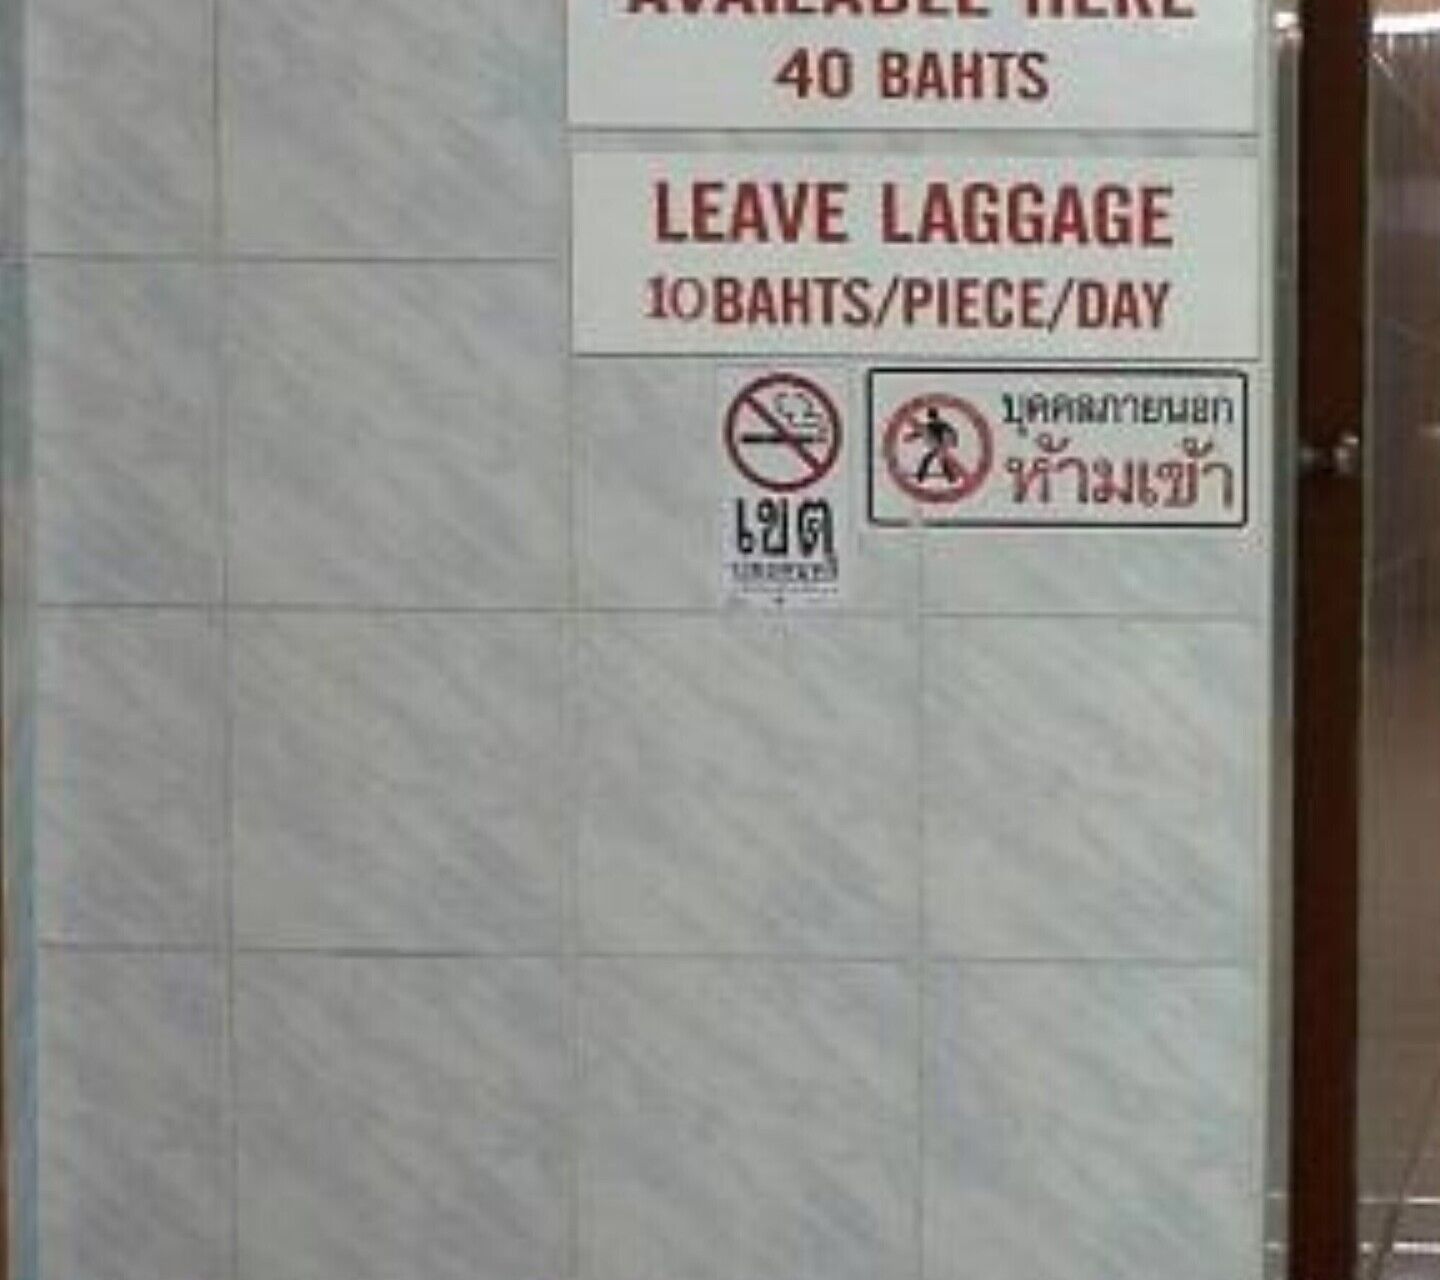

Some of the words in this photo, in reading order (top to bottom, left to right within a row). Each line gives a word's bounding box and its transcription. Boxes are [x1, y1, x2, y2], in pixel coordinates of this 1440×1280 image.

[774, 48, 852, 98] 40
[880, 50, 1049, 100] BAHTS
[656, 181, 848, 243] LEAVE
[882, 182, 1173, 247] LAGGAGE
[1001, 391, 1235, 436] บุคคลภายนอก
[1004, 432, 1235, 510] ห้ามเข้า
[736, 496, 834, 557] เขต
